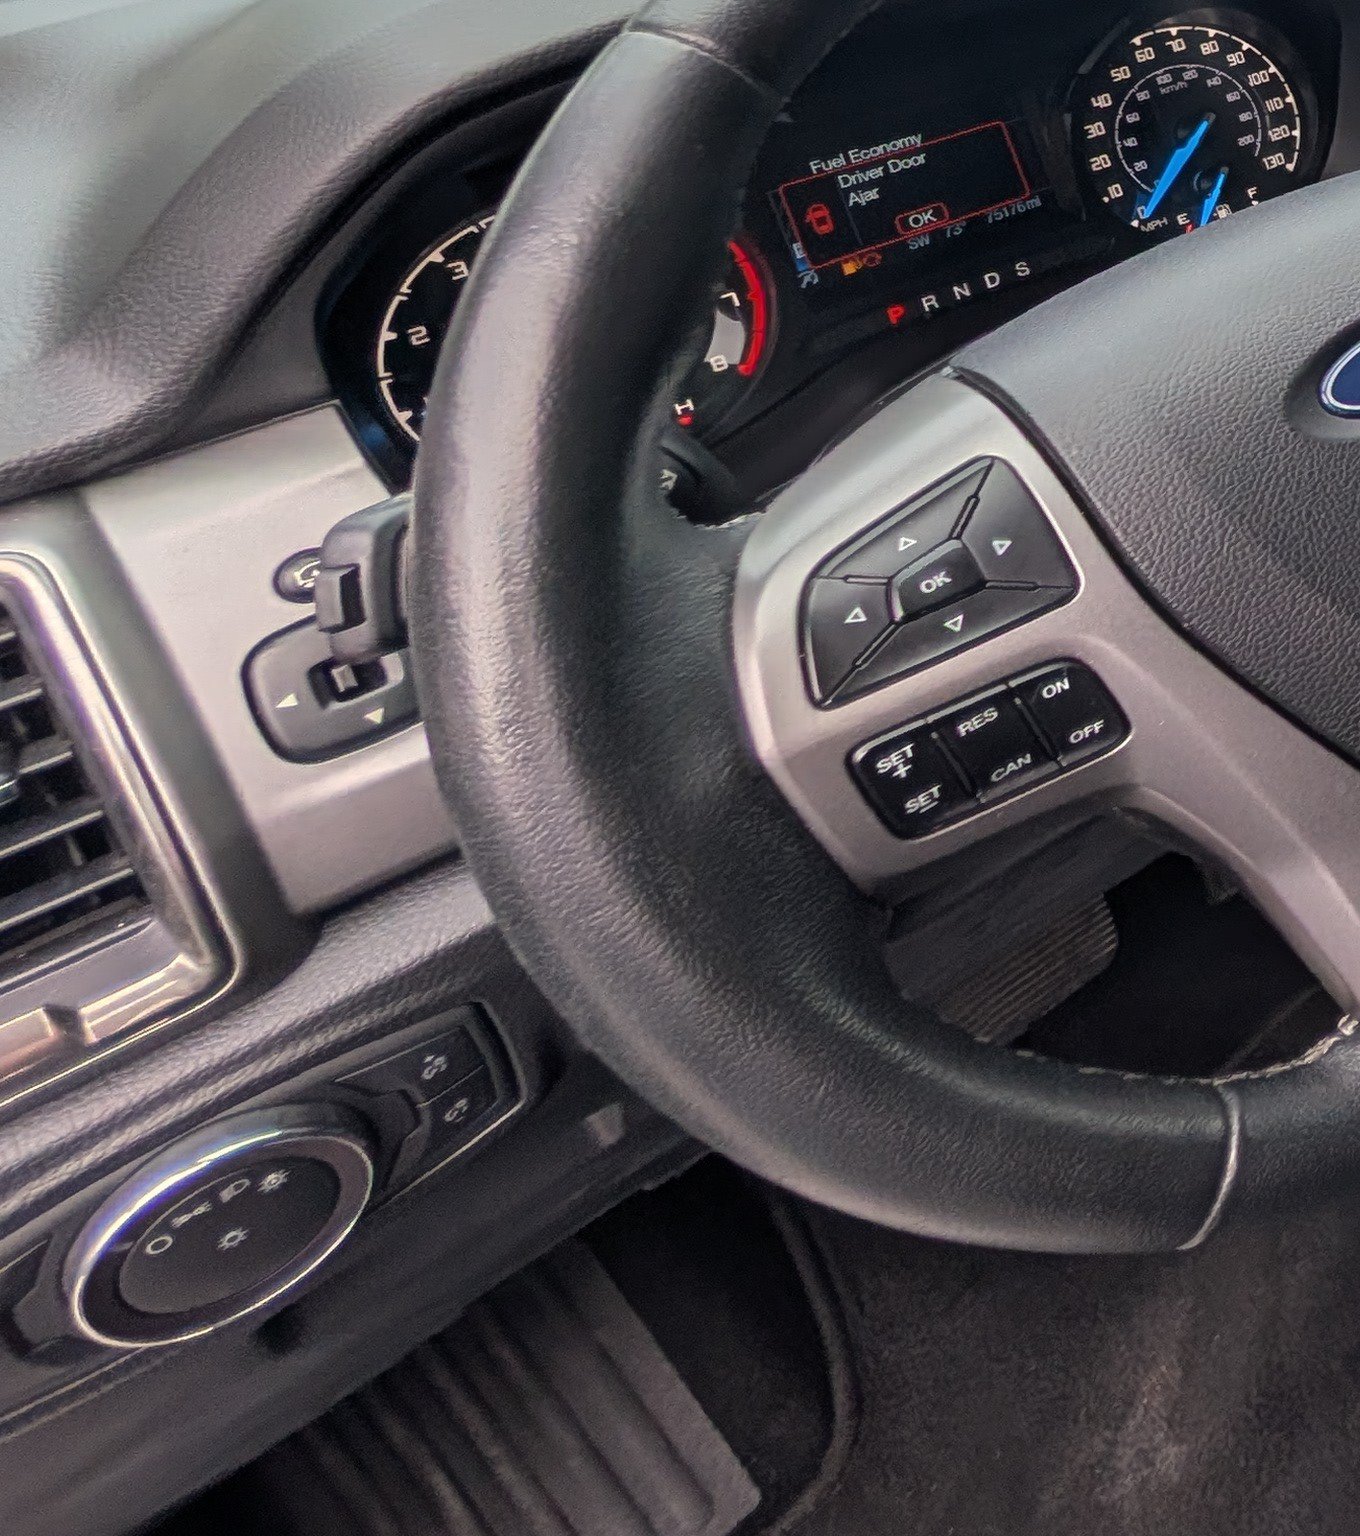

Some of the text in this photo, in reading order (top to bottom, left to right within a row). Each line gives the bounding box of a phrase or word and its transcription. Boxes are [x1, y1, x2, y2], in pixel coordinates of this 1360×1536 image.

[1165, 38, 1187, 53] 70
[1200, 40, 1219, 55] 80
[1135, 47, 1155, 63] 60
[1226, 51, 1246, 67] 90
[1110, 66, 1131, 82] 50
[1248, 70, 1270, 87] 100
[1160, 81, 1188, 95] km/h
[1091, 93, 1113, 109] 40
[1265, 96, 1284, 113] 110
[1084, 121, 1106, 139] 30
[1268, 125, 1291, 141] 120
[810, 132, 923, 175] Fuel Economy
[1262, 153, 1285, 170] 130
[838, 152, 926, 190] Driver Door
[1089, 154, 1112, 171] 20
[848, 187, 880, 207] Ajar
[1108, 184, 1124, 199] 10
[1247, 186, 1258, 199] F
[909, 209, 938, 228] OK
[1140, 217, 1168, 233] MPH
[1177, 213, 1190, 226] E
[908, 235, 931, 250] SW
[445, 259, 470, 281] 3
[887, 261, 1031, 325] P R N D S
[407, 324, 431, 347] 2
[710, 353, 728, 373] 8
[673, 398, 695, 415] H
[919, 570, 952, 595] OK
[1042, 677, 1070, 700] ON
[956, 705, 999, 737] RES
[1069, 719, 1105, 744] OFF
[876, 742, 916, 776] SET
[990, 752, 1032, 783] CAN
[904, 783, 942, 814] SET
